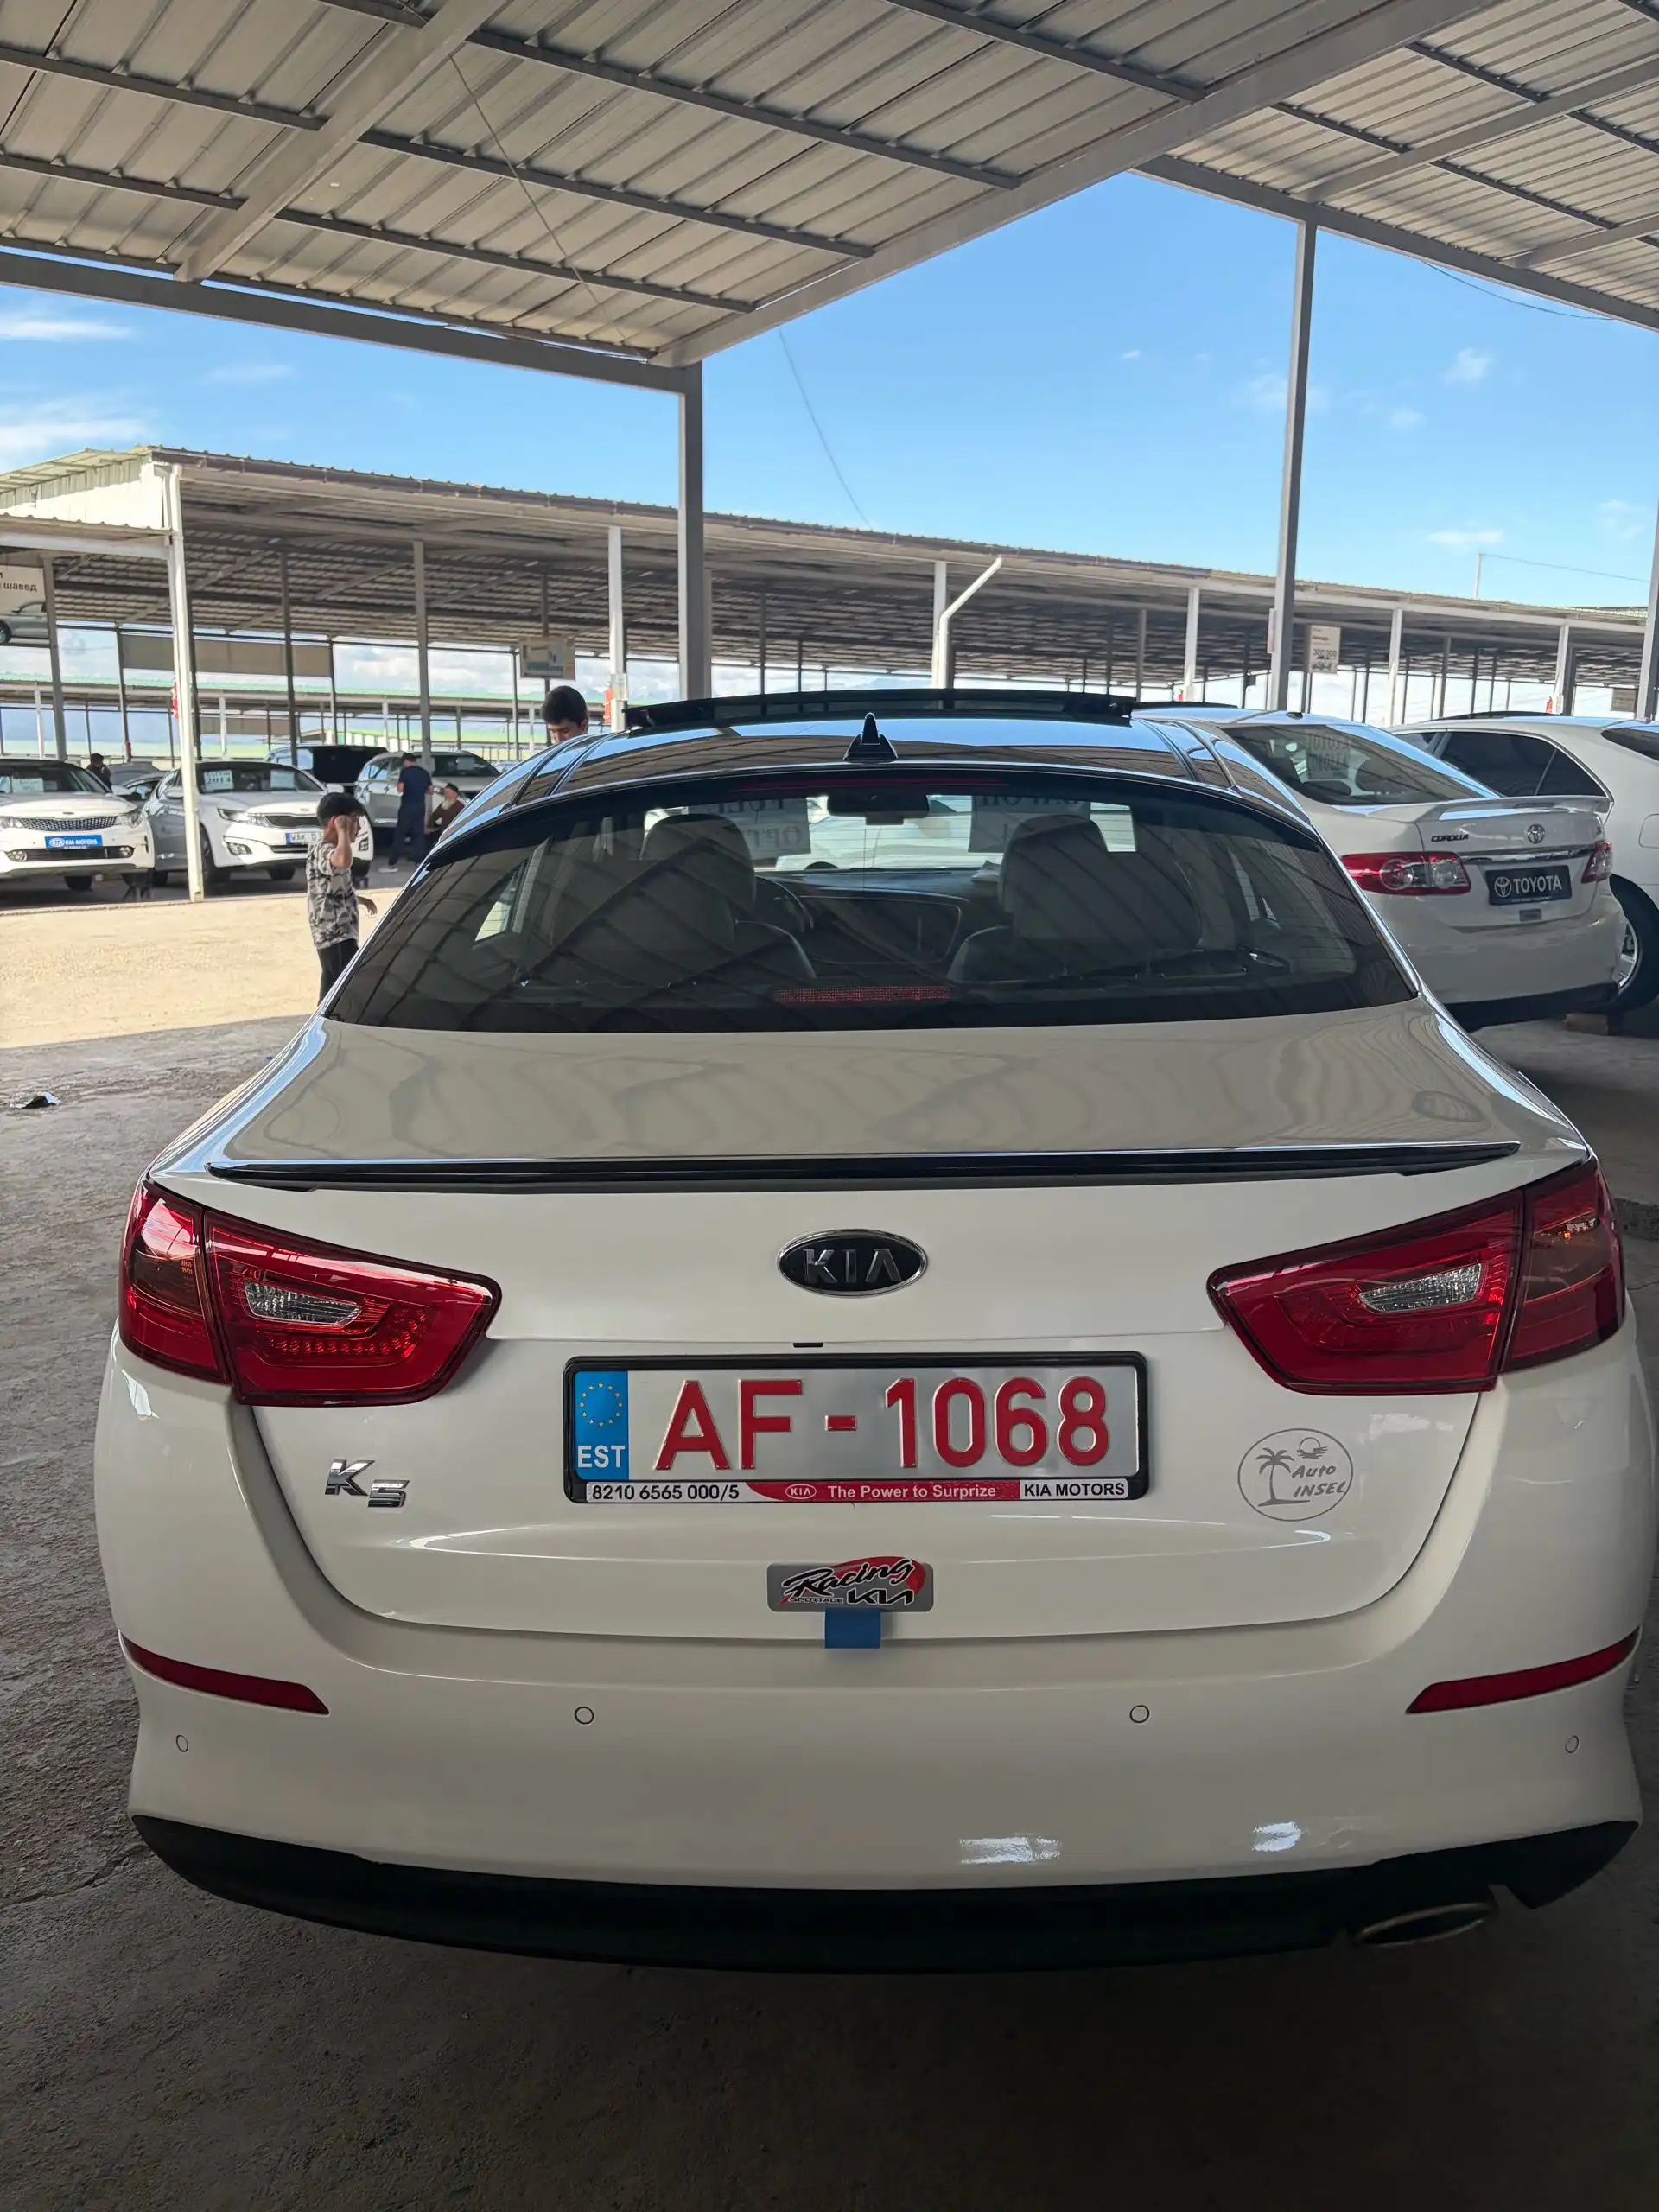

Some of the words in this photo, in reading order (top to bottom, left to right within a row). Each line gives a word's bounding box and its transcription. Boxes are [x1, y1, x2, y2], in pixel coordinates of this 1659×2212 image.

[1431, 834, 1469, 842] COROLLA
[1513, 875, 1562, 894] TOYOTA
[803, 1248, 902, 1284] KIA
[653, 1379, 804, 1471] AF
[884, 1376, 1110, 1468] 1068
[577, 1445, 626, 1468] EST
[1291, 1465, 1337, 1478] Auto
[325, 1459, 410, 1508] K5
[790, 1487, 811, 1497] KIA
[828, 1485, 855, 1498] The
[861, 1485, 908, 1498] Power
[912, 1485, 927, 1497] to
[932, 1484, 996, 1500] Surprize
[1024, 1483, 1051, 1497] KIA
[1056, 1482, 1125, 1497] MOTORS
[1293, 1481, 1346, 1497] INSEL
[592, 1484, 635, 1500] 8210
[639, 1484, 683, 1500] 6565
[687, 1484, 740, 1501] 000/5
[781, 1558, 915, 1597] Racing
